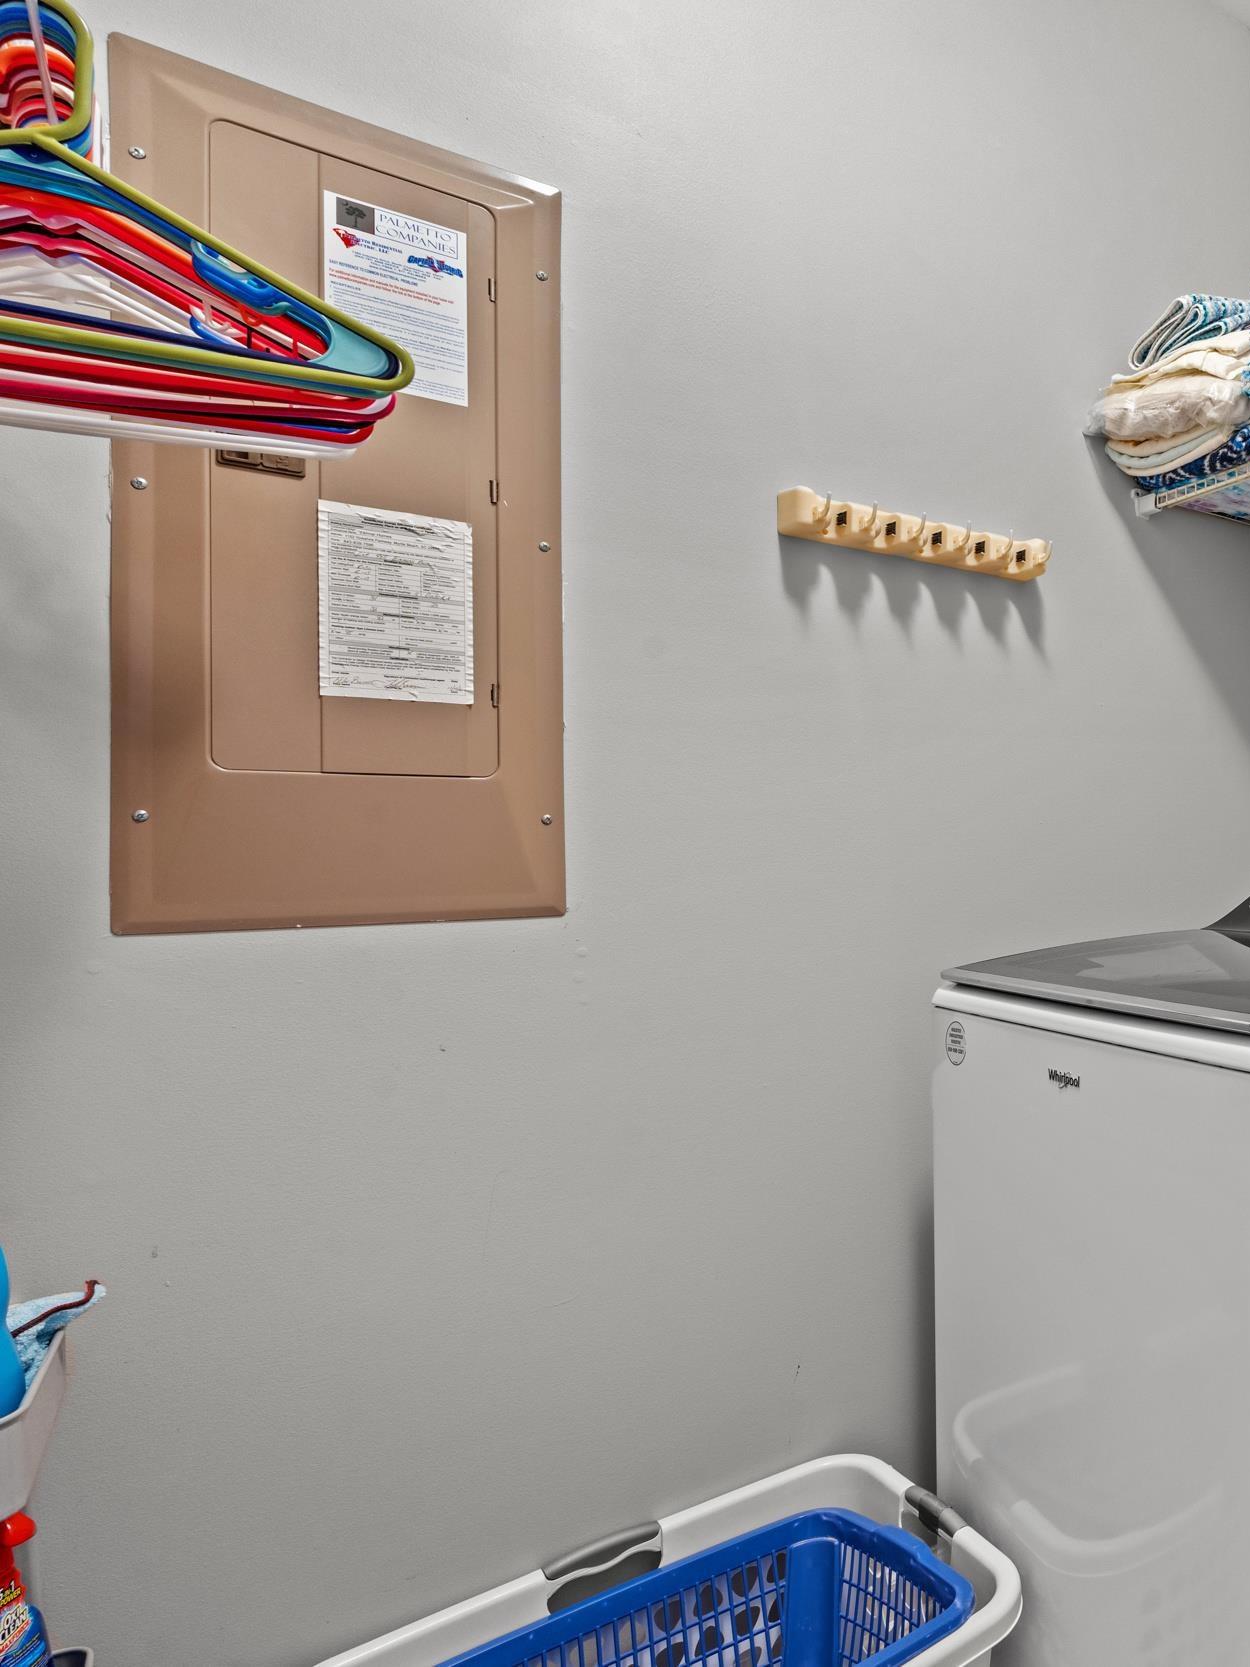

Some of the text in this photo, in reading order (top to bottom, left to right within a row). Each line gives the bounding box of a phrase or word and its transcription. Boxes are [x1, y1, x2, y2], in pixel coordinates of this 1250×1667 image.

[376, 225, 456, 254] COMPANIES
[380, 214, 452, 242] PALMETTO
[1048, 1068, 1080, 1089] Whirlpool
[0, 1611, 27, 1644] CLEAN
